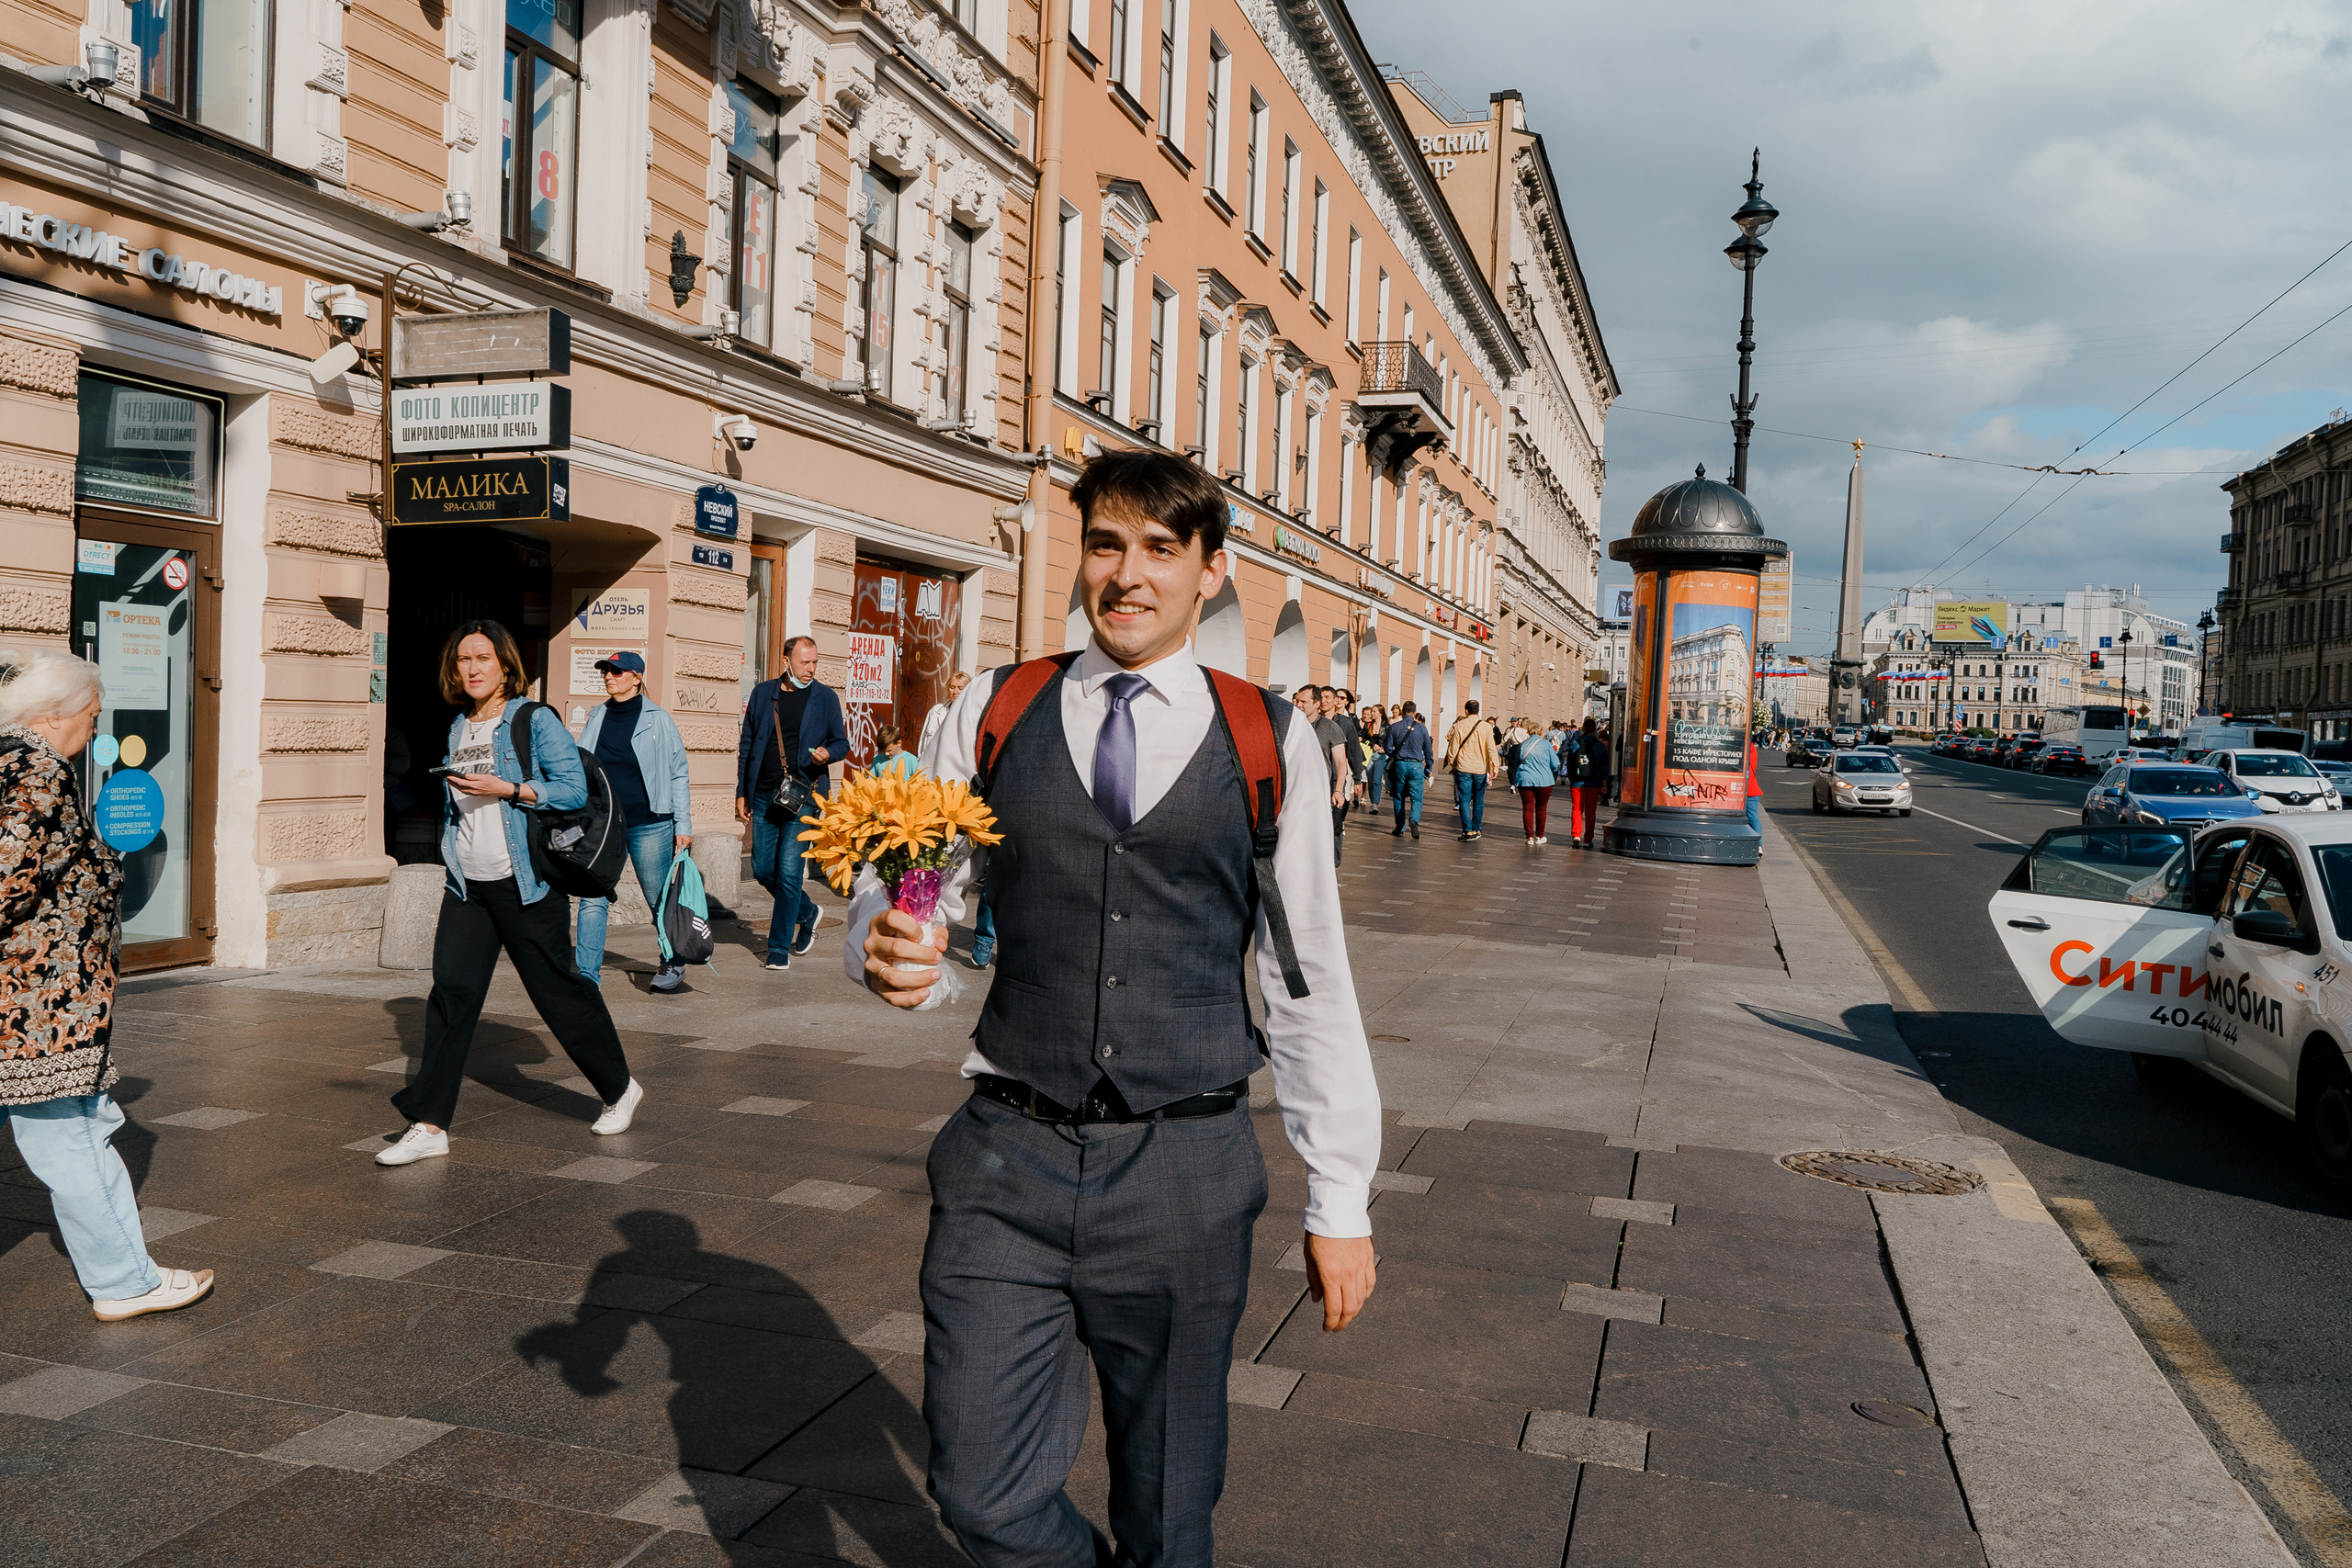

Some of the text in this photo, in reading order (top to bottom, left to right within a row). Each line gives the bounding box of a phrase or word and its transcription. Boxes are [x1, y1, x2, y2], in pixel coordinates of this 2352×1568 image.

[1415, 128, 1489, 154] ВСКИЙ
[538, 150, 559, 200] 8
[139, 248, 283, 315] САЛОНЫ
[401, 393, 539, 421] ФОТО КОПИЦЕНТР
[402, 422, 537, 442] ШИРОКОФОРМАТНАЯ ПЕЧАТЬ
[411, 471, 530, 501] МАЛИКА
[444, 501, 495, 513] SPA-САЛОН
[704, 501, 733, 518] НЕВСКИЙ
[708, 550, 719, 565] 112
[852, 637, 885, 659] АРЕНДА
[853, 662, 882, 682] 420м2
[850, 687, 889, 699] 8-911-715-12-72
[1682, 748, 1702, 756] КАФЕ
[1690, 756, 1717, 764] ОДНОЙ
[2313, 963, 2341, 986] 451
